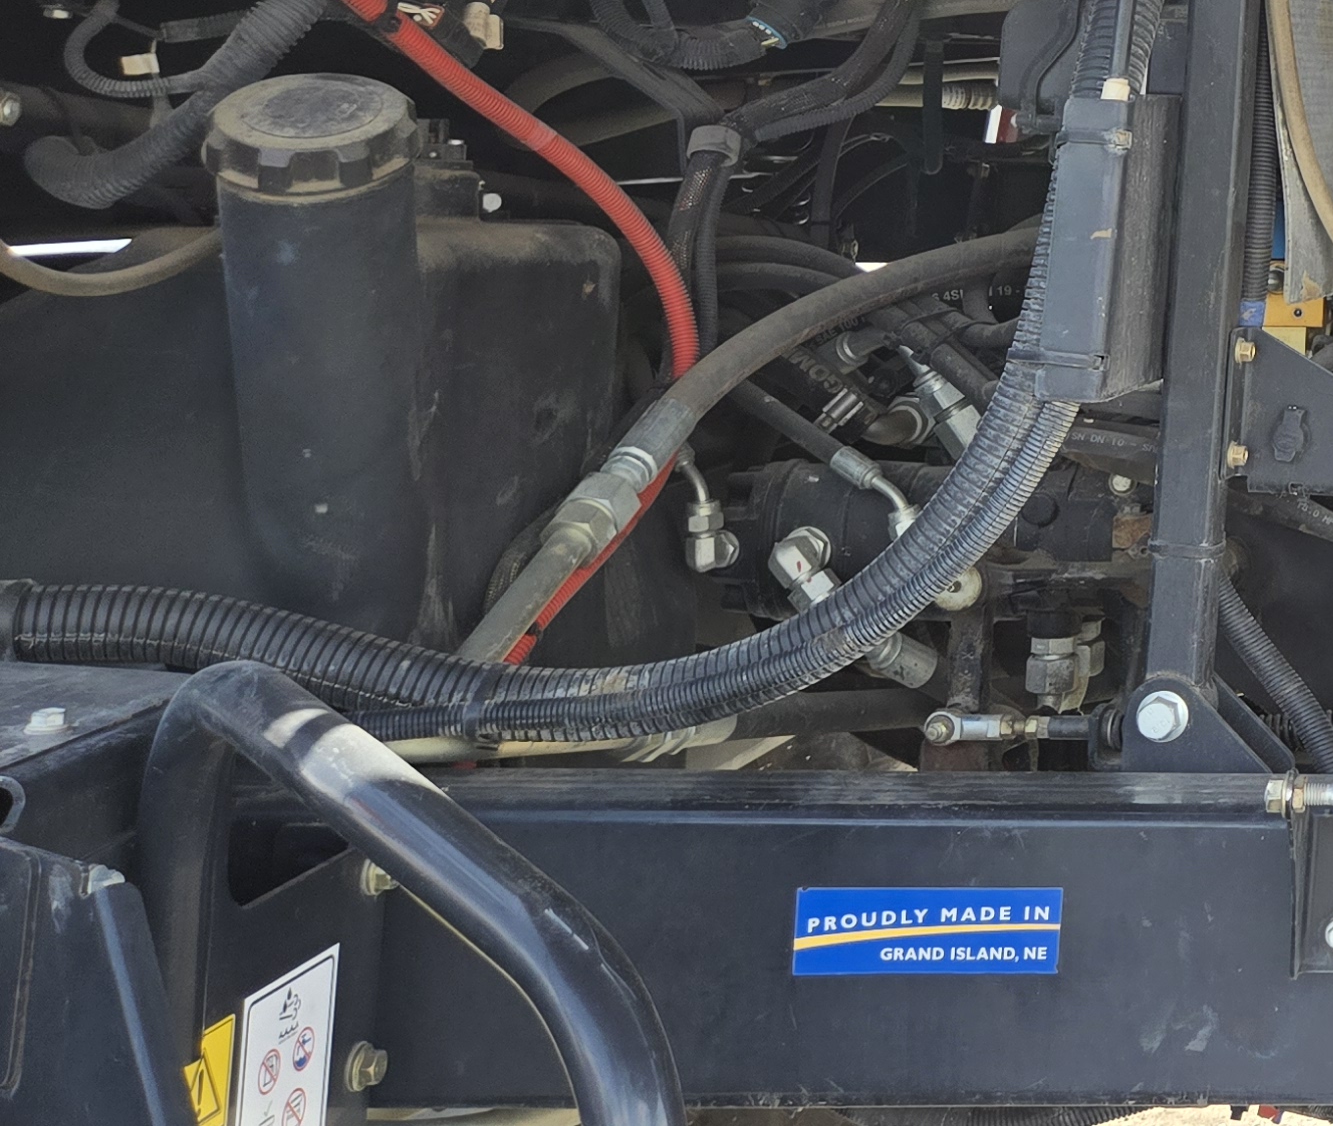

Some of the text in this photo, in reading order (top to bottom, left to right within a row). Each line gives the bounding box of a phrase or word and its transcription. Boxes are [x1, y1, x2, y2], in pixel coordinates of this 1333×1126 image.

[807, 906, 1050, 933] PROUDLY MADE IN
[880, 946, 1048, 962] GRAND ISLAND, NE
